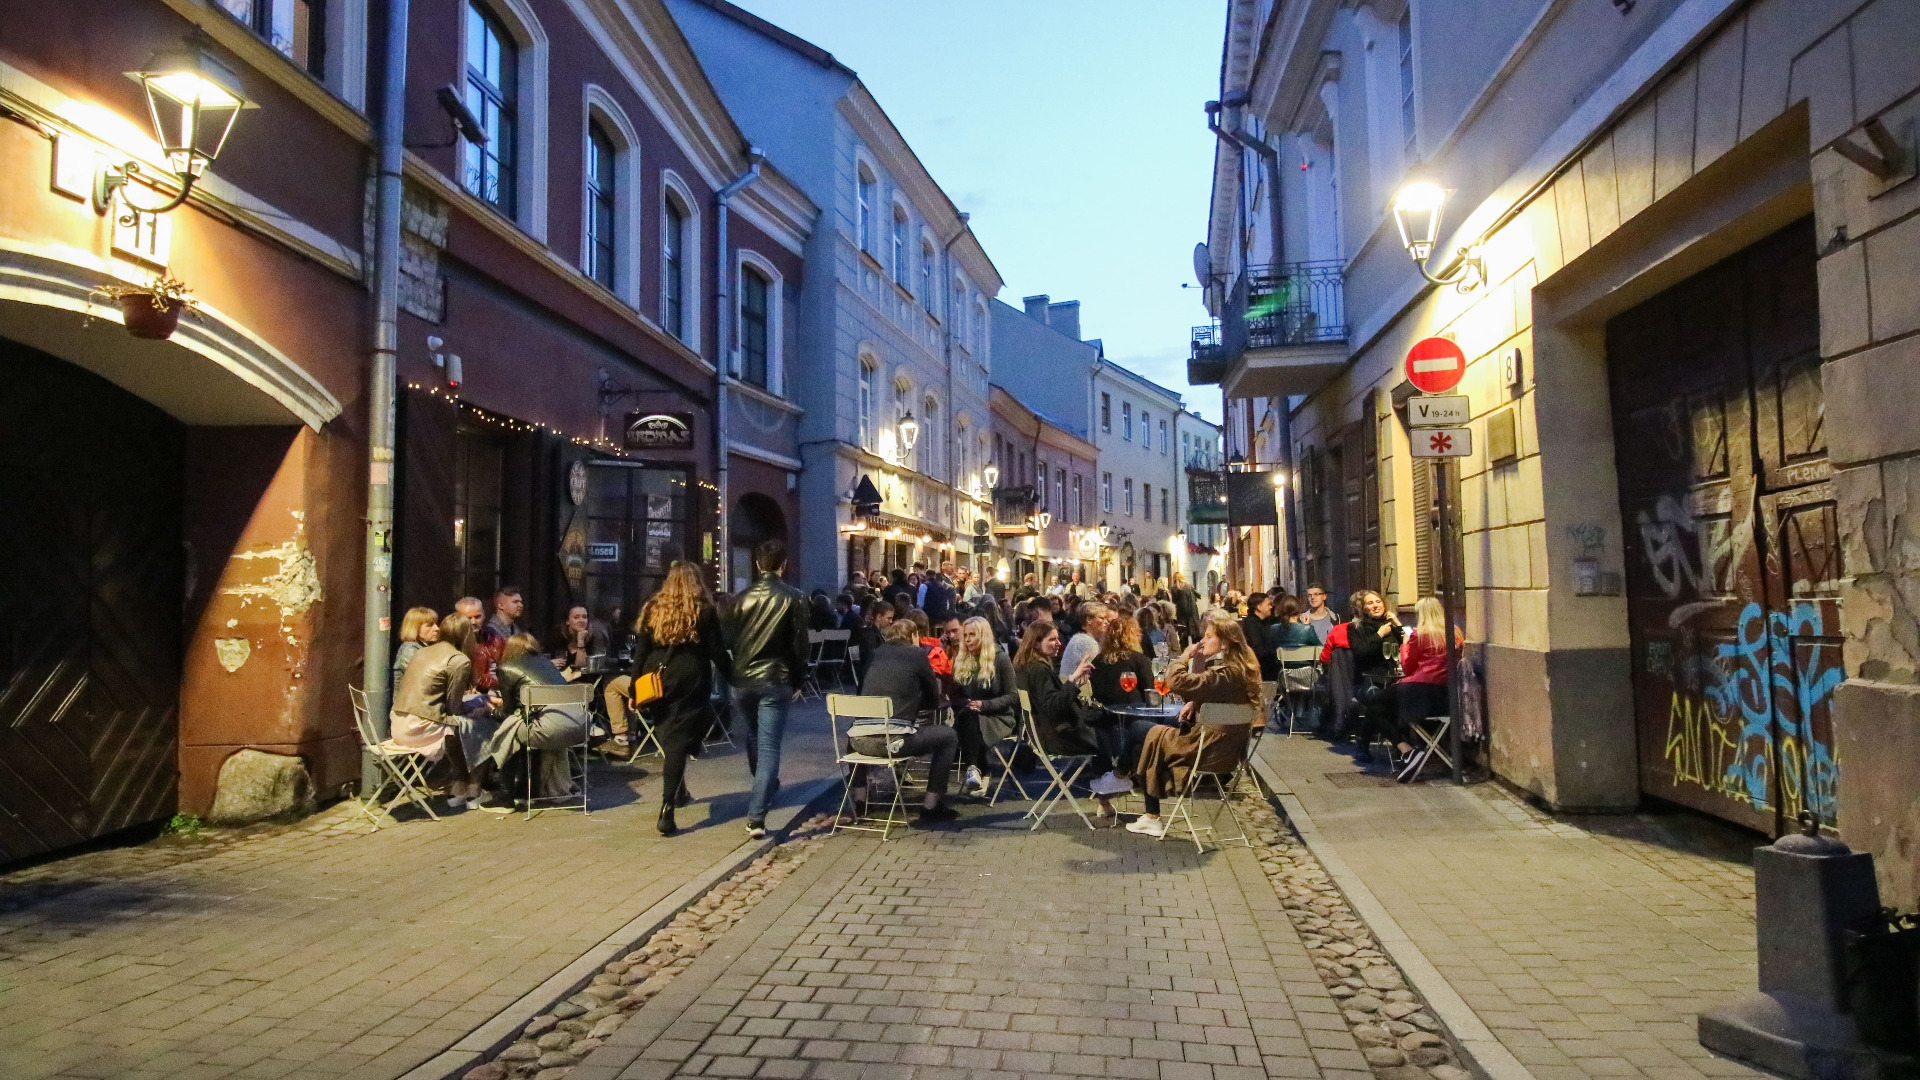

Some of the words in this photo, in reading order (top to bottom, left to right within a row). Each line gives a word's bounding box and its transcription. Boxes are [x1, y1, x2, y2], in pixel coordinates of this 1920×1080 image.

[1505, 355, 1513, 382] 8
[1418, 404, 1429, 418] V
[1431, 410, 1454, 418] 19-24
